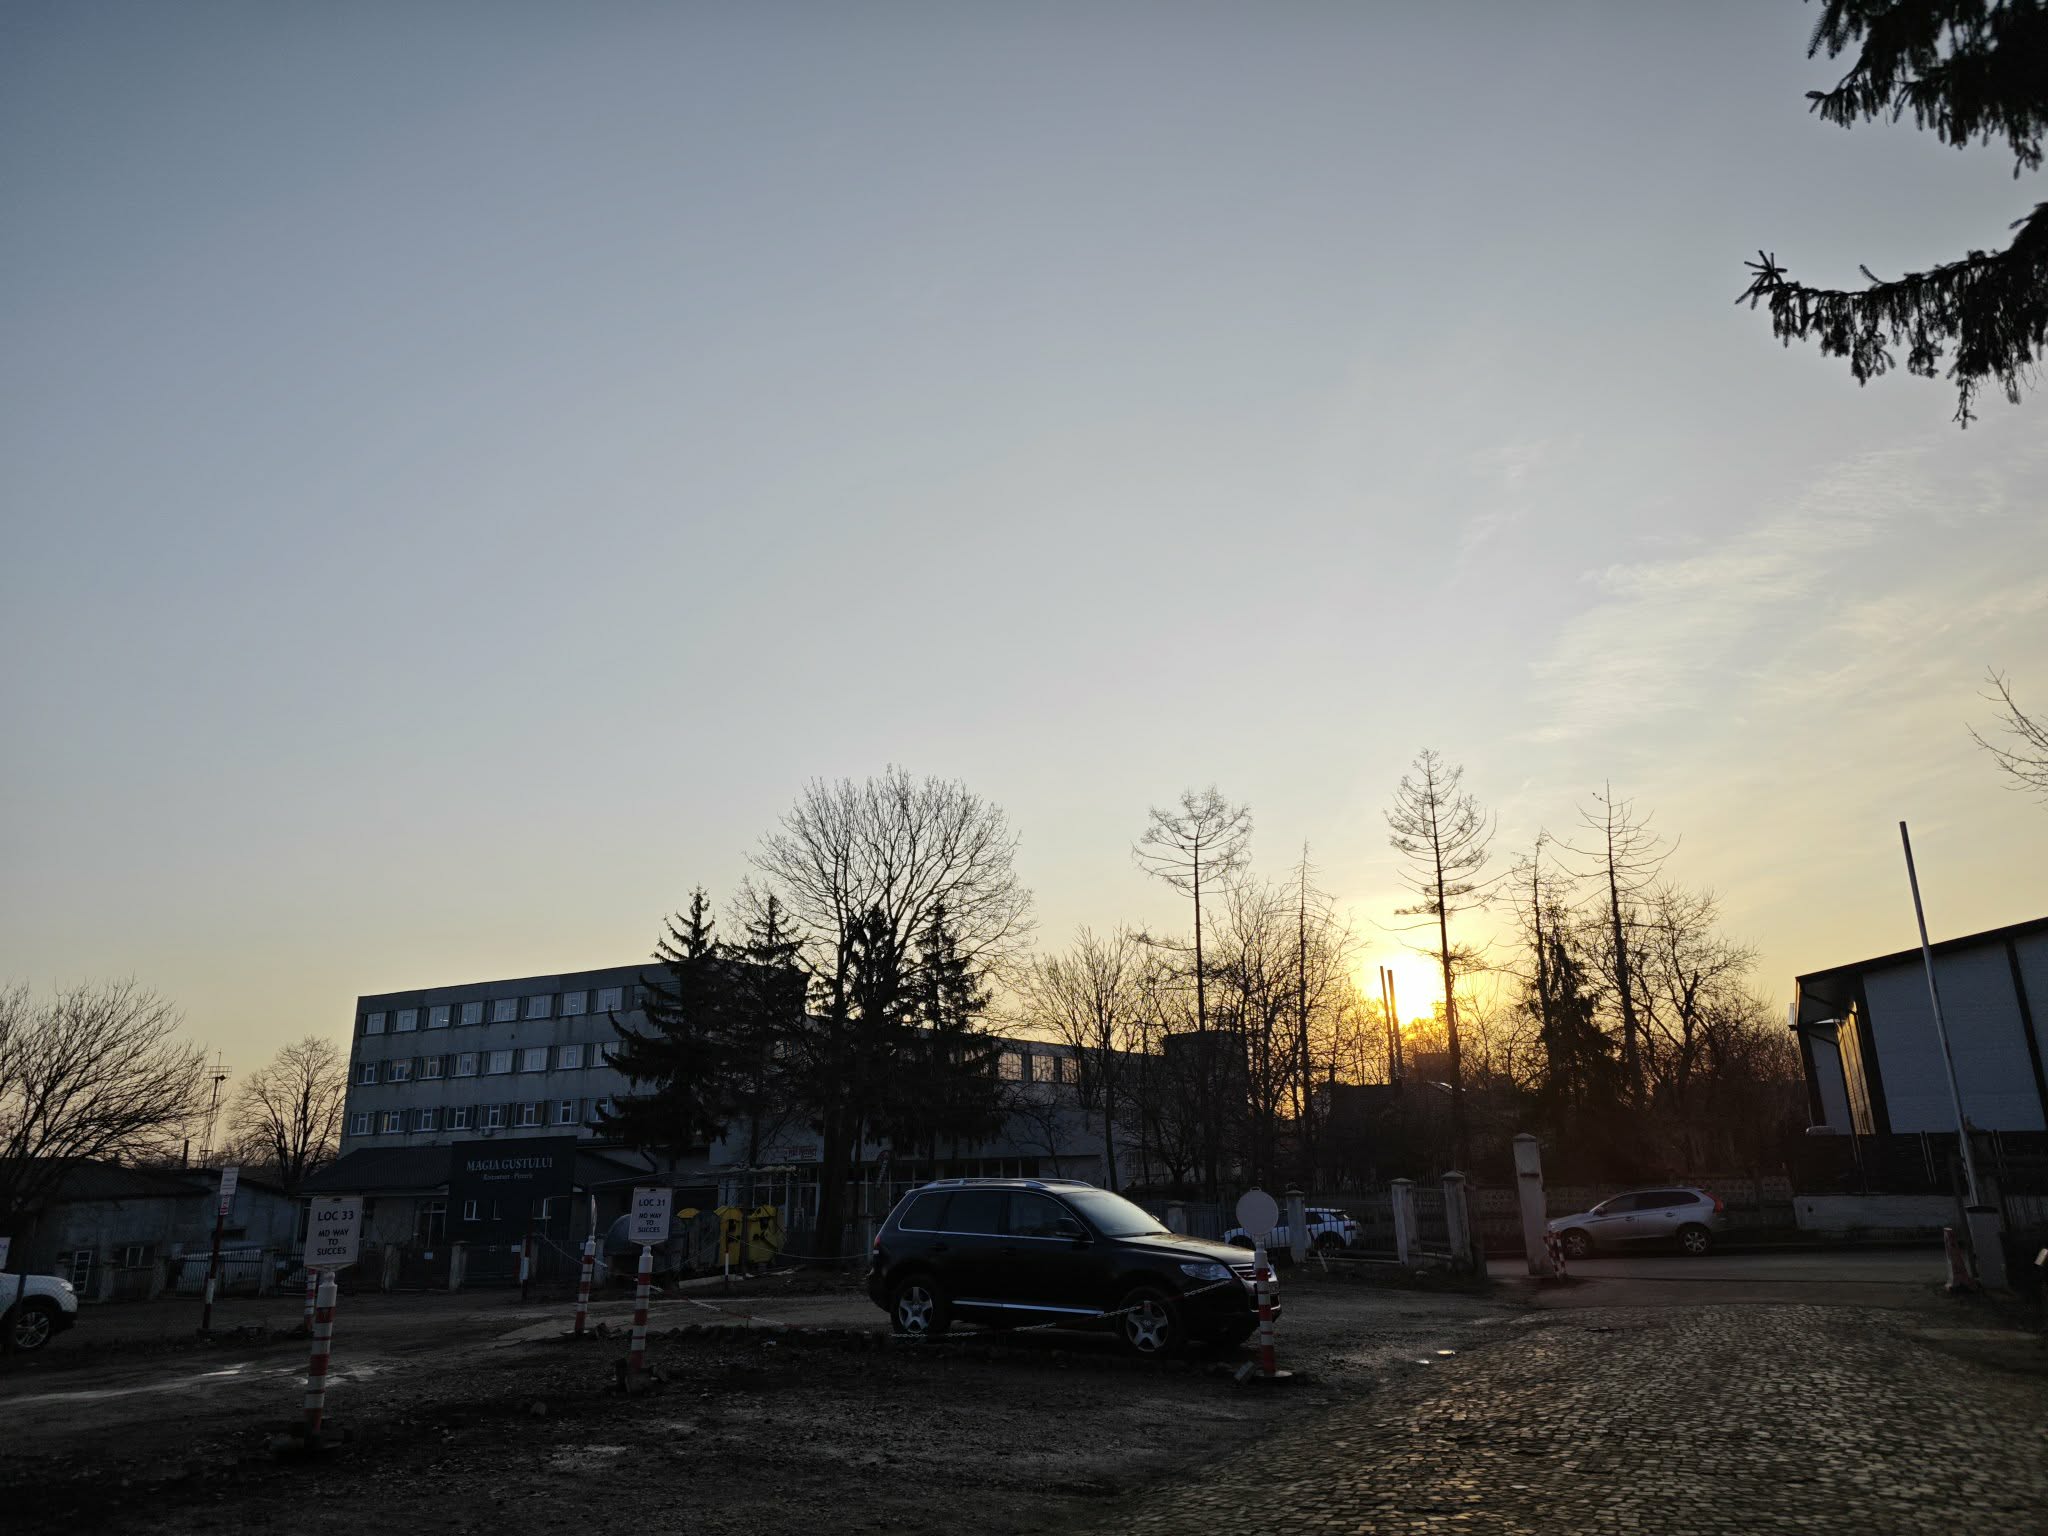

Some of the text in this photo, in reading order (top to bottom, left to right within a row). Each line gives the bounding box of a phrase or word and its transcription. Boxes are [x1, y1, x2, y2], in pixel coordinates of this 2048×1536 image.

[466, 1157, 552, 1171] MAGIA GUSTULUI
[318, 1210, 354, 1221] LOC 33
[333, 1228, 349, 1237] WAY
[328, 1238, 338, 1246] TO
[317, 1247, 346, 1256] SUCCES
